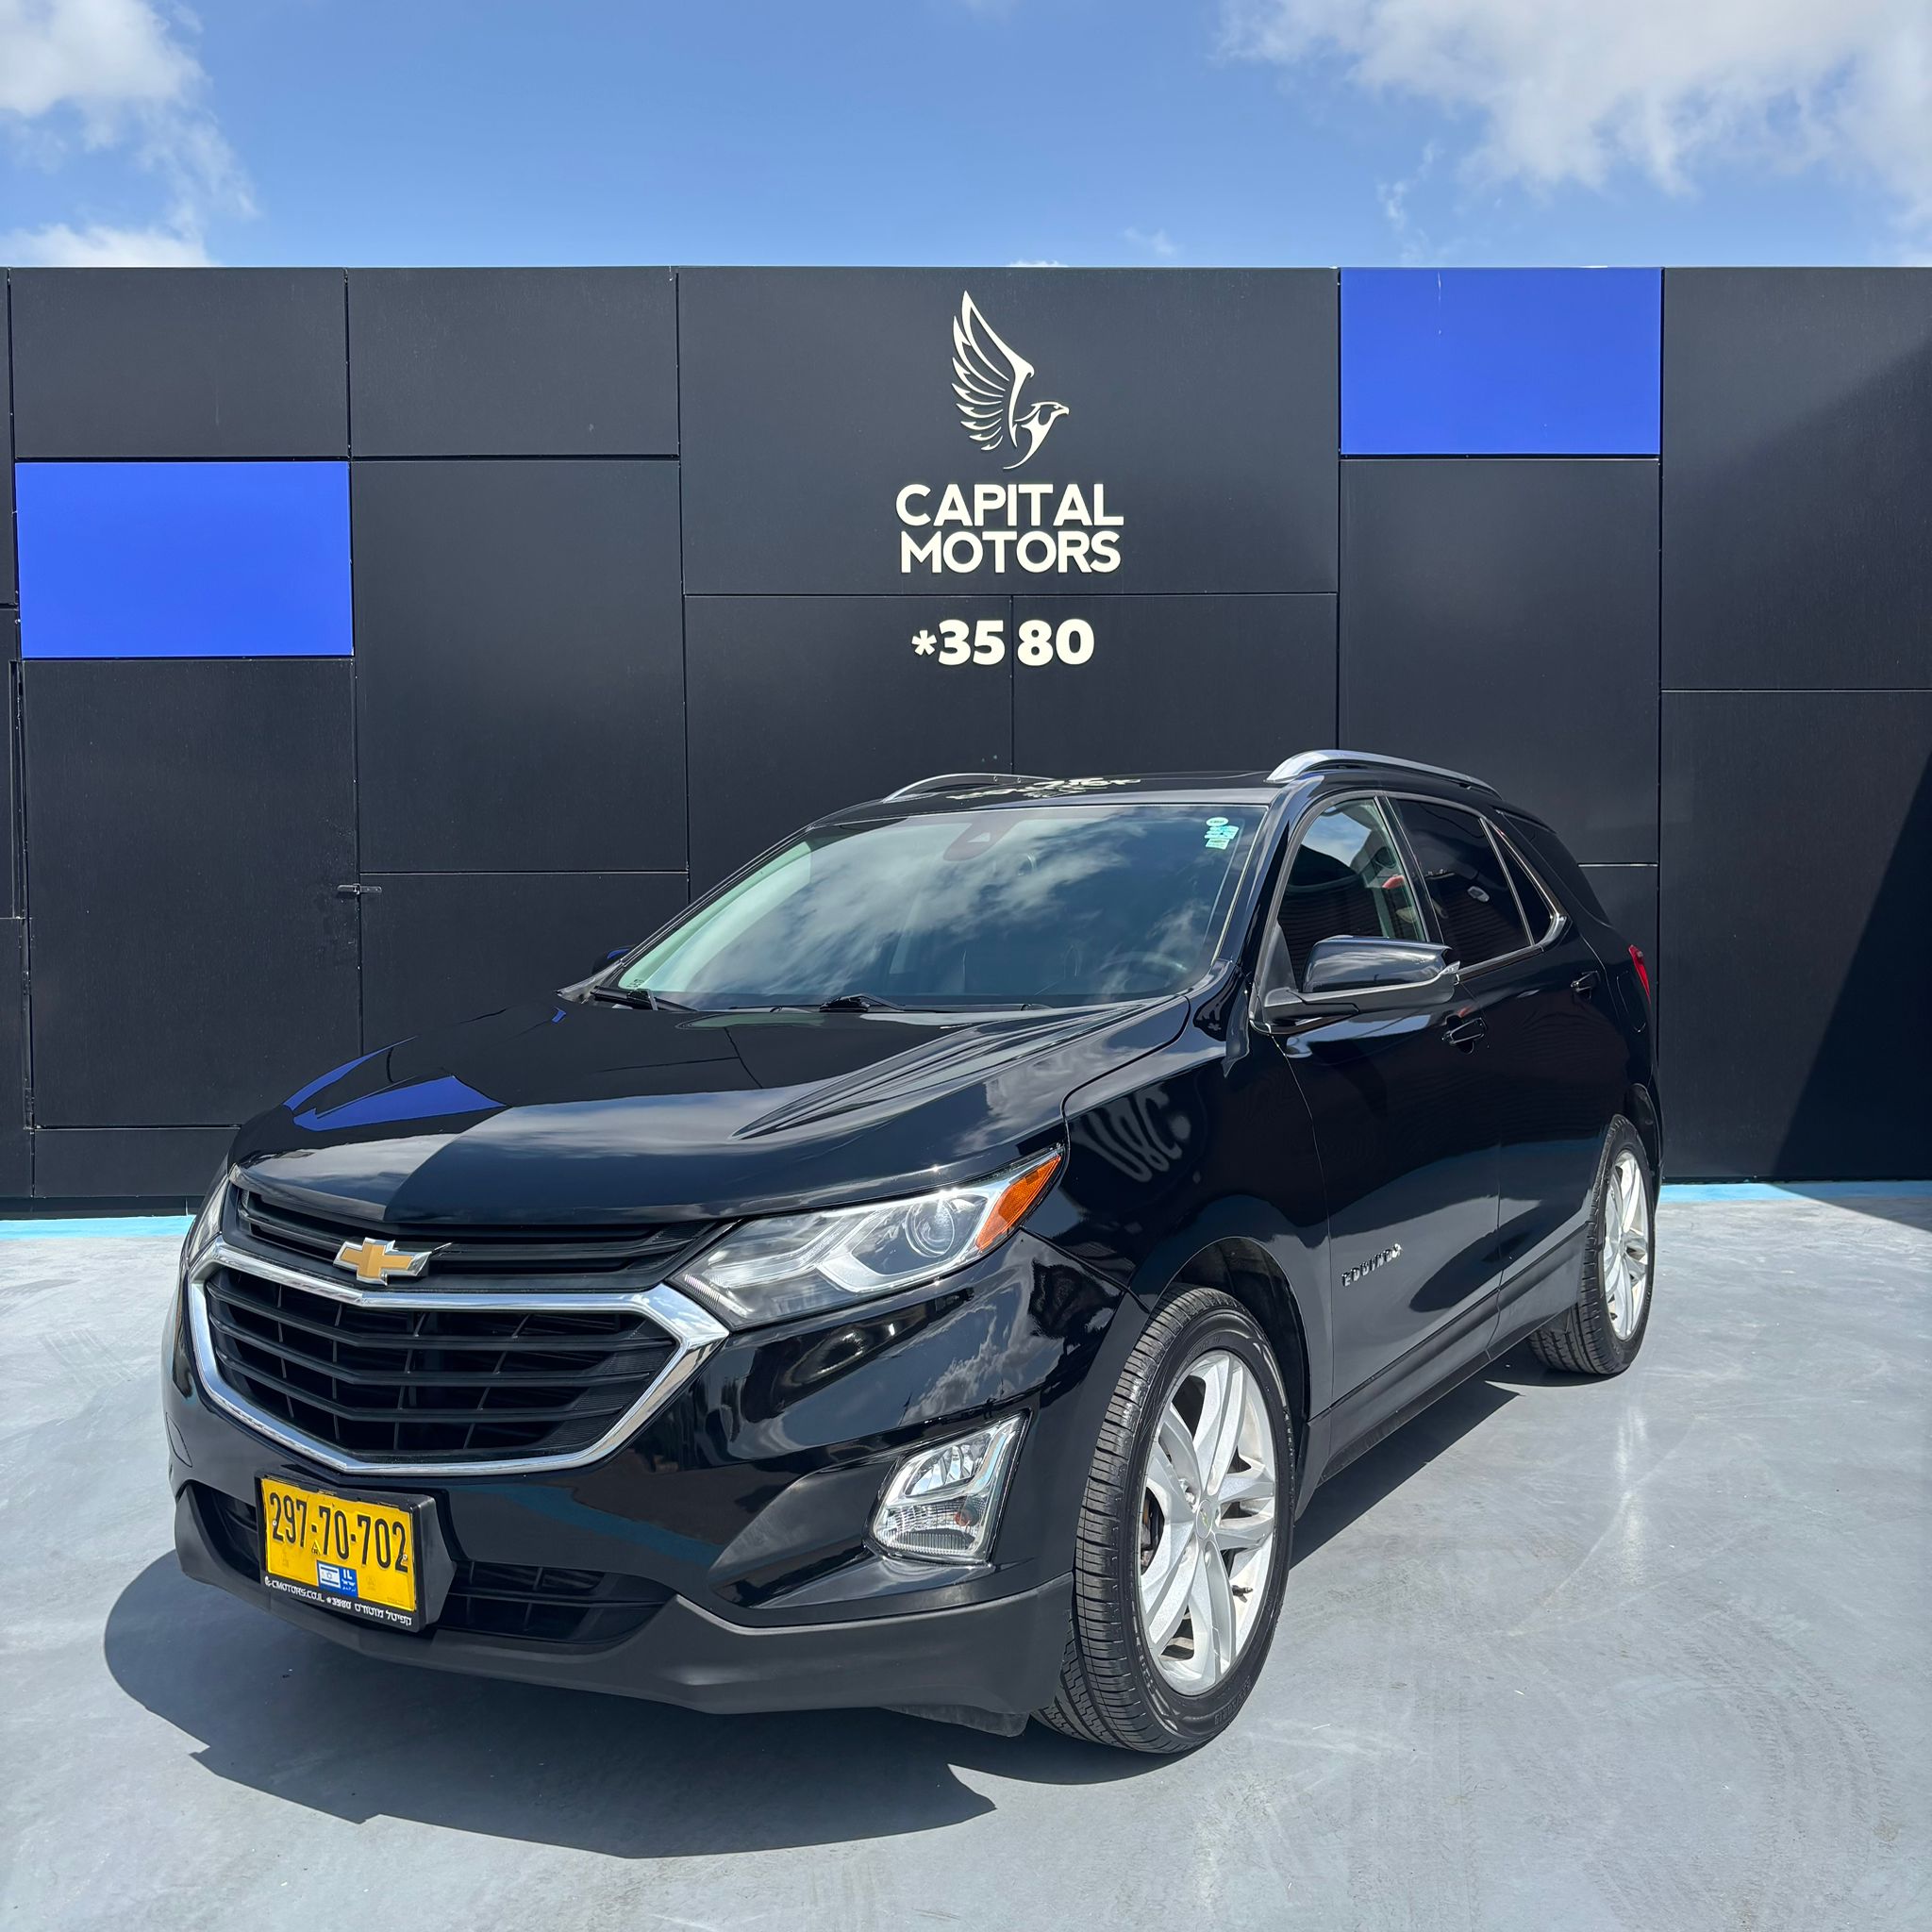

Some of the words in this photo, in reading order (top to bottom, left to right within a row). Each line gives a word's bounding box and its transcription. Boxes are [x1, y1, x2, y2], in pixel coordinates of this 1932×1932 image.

[895, 483, 1124, 526] CAPITAL
[901, 530, 1121, 574] MOTORS
[342, 1569, 353, 1580] IL
